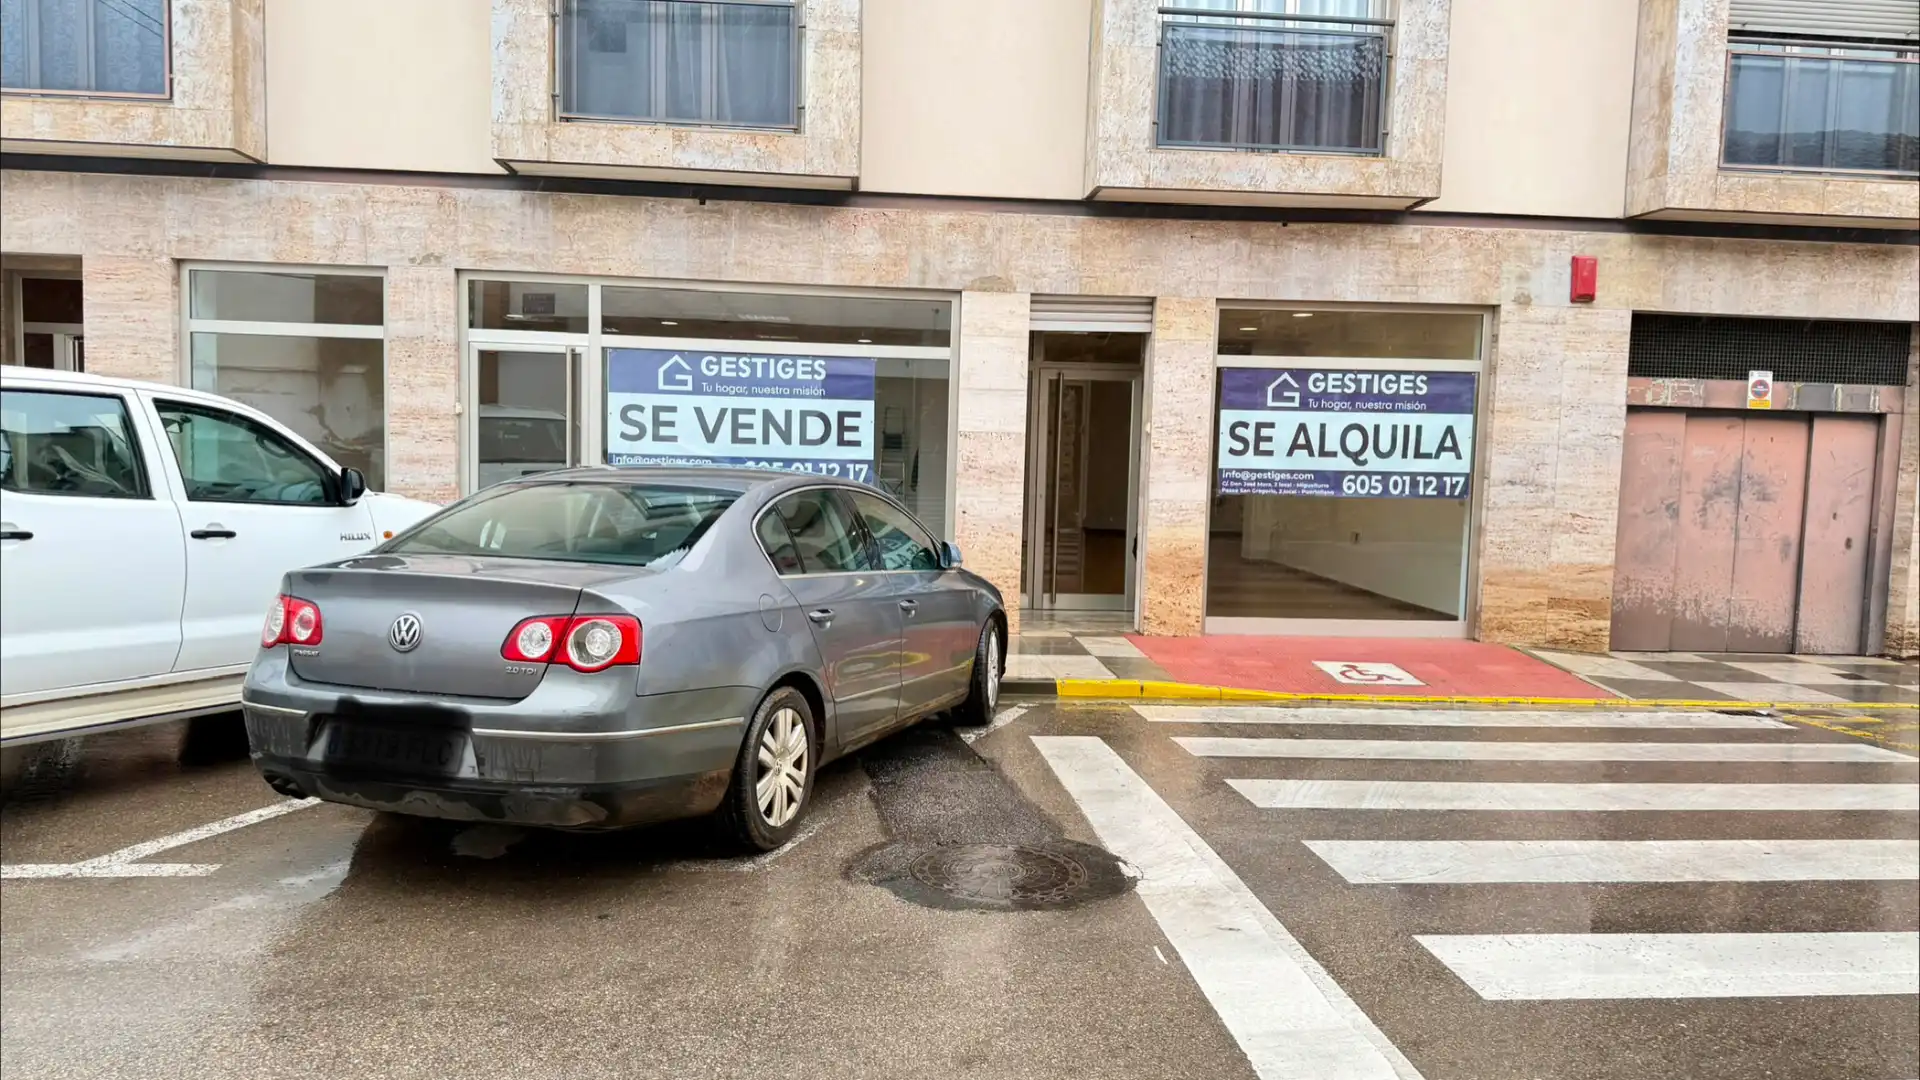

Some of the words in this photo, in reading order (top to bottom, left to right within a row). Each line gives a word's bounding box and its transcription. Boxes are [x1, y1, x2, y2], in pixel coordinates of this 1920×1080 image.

[700, 356, 827, 381] GESTIGES
[701, 382, 713, 393] Tu
[715, 382, 749, 395] hogar,
[751, 384, 790, 395] nuestra
[792, 385, 826, 396] misión
[1307, 372, 1428, 396] GESTIGES
[1308, 398, 1319, 408] Tu
[1321, 399, 1352, 411] hogar,
[1355, 401, 1392, 411] nuestra
[1395, 400, 1427, 411] misión
[619, 404, 679, 442] SE
[693, 406, 863, 448] VENDE
[1227, 420, 1277, 457] SE
[1285, 422, 1463, 467] ALQUILA
[846, 463, 869, 483] 17
[1222, 470, 1315, 480] info@gestiges.com
[1342, 474, 1383, 495] 605
[1388, 475, 1411, 495] 01
[1416, 476, 1438, 496] 12
[1443, 476, 1465, 496] 17
[340, 532, 371, 541] HILUX
